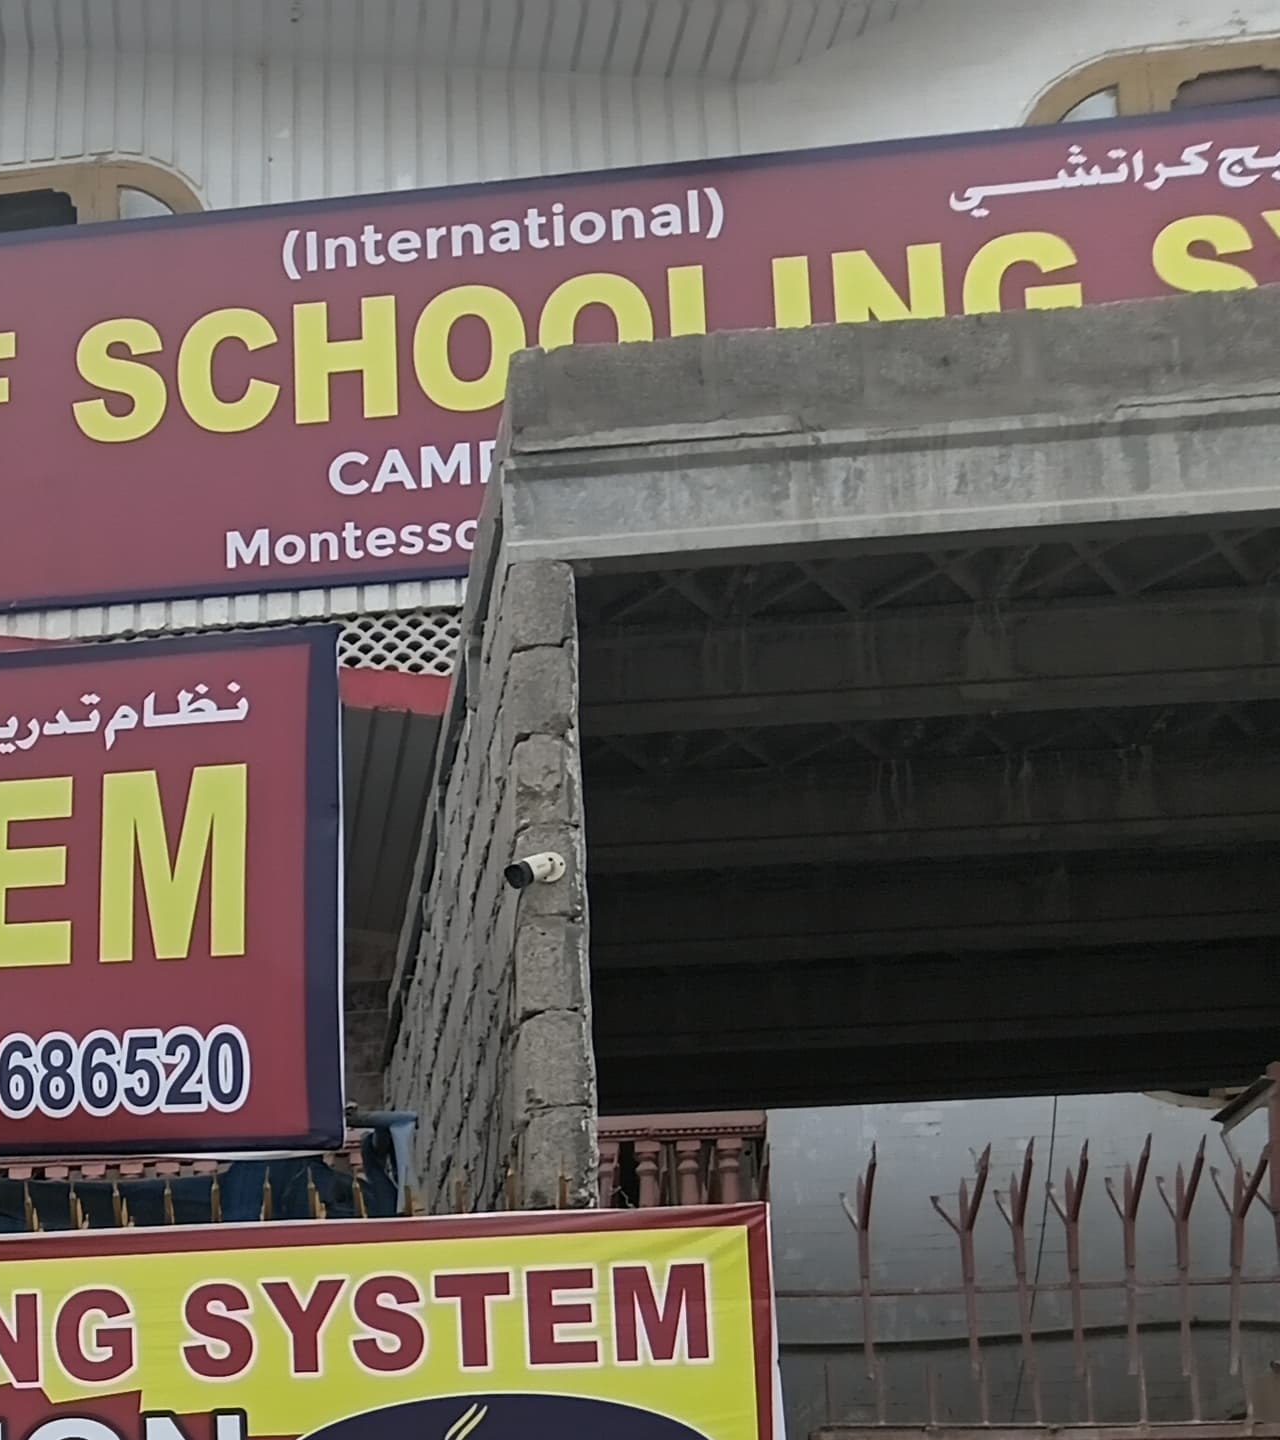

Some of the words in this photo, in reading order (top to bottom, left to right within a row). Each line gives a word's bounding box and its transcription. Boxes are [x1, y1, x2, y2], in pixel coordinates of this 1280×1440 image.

[949, 141, 1213, 218] كراتشي
[280, 187, 726, 281] (International)
[1152, 208, 1280, 292] S
[105, 682, 249, 749] نظام
[182, 1260, 713, 1380] SYSTEM
